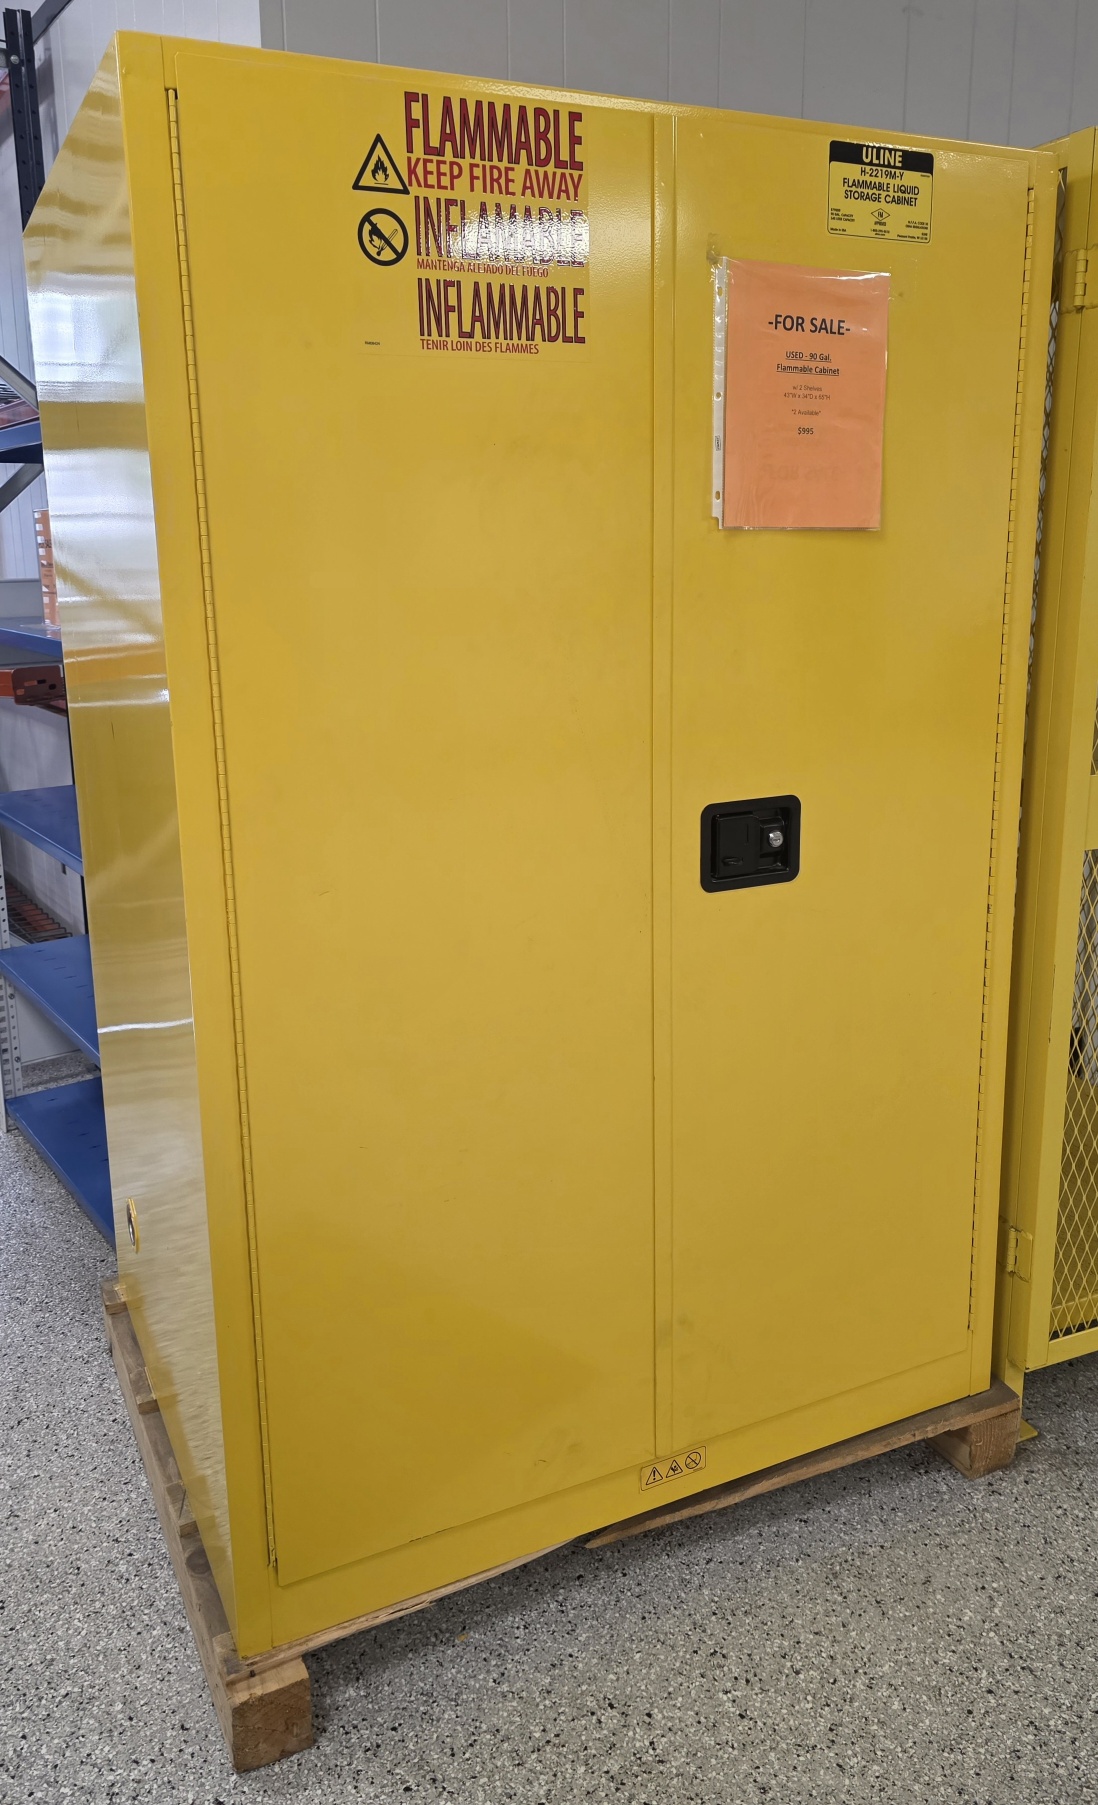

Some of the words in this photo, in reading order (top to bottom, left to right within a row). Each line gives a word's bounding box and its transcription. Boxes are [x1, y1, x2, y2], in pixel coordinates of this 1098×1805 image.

[404, 91, 584, 171] FLAMMABLE
[862, 147, 903, 167] ULINE
[406, 156, 463, 191] KEEP
[469, 163, 516, 196] FIRE
[521, 168, 583, 202] AWAY
[860, 167, 904, 181] H-2219M-Y
[842, 177, 890, 193] FLAMMABLE
[893, 183, 920, 196] LIQUID
[844, 190, 882, 203] STORAGE
[884, 195, 918, 207] CABINET
[417, 258, 465, 273] MANTENGA
[467, 262, 504, 275] ALEJADO
[505, 265, 521, 276] DEL
[522, 266, 549, 278] FUEGO
[417, 277, 586, 344] INFLAMMABLE
[768, 314, 805, 332] -FOR
[809, 317, 851, 335] SALE-
[420, 338, 449, 351] TENIR
[451, 340, 473, 352] LOIN
[475, 341, 492, 353] DES
[495, 342, 539, 355] FLAMMES
[785, 351, 804, 359] USED
[819, 353, 832, 362] Gal.
[776, 363, 813, 373] Flammable
[814, 366, 840, 375] Cabinet
[798, 427, 814, 435] $995
